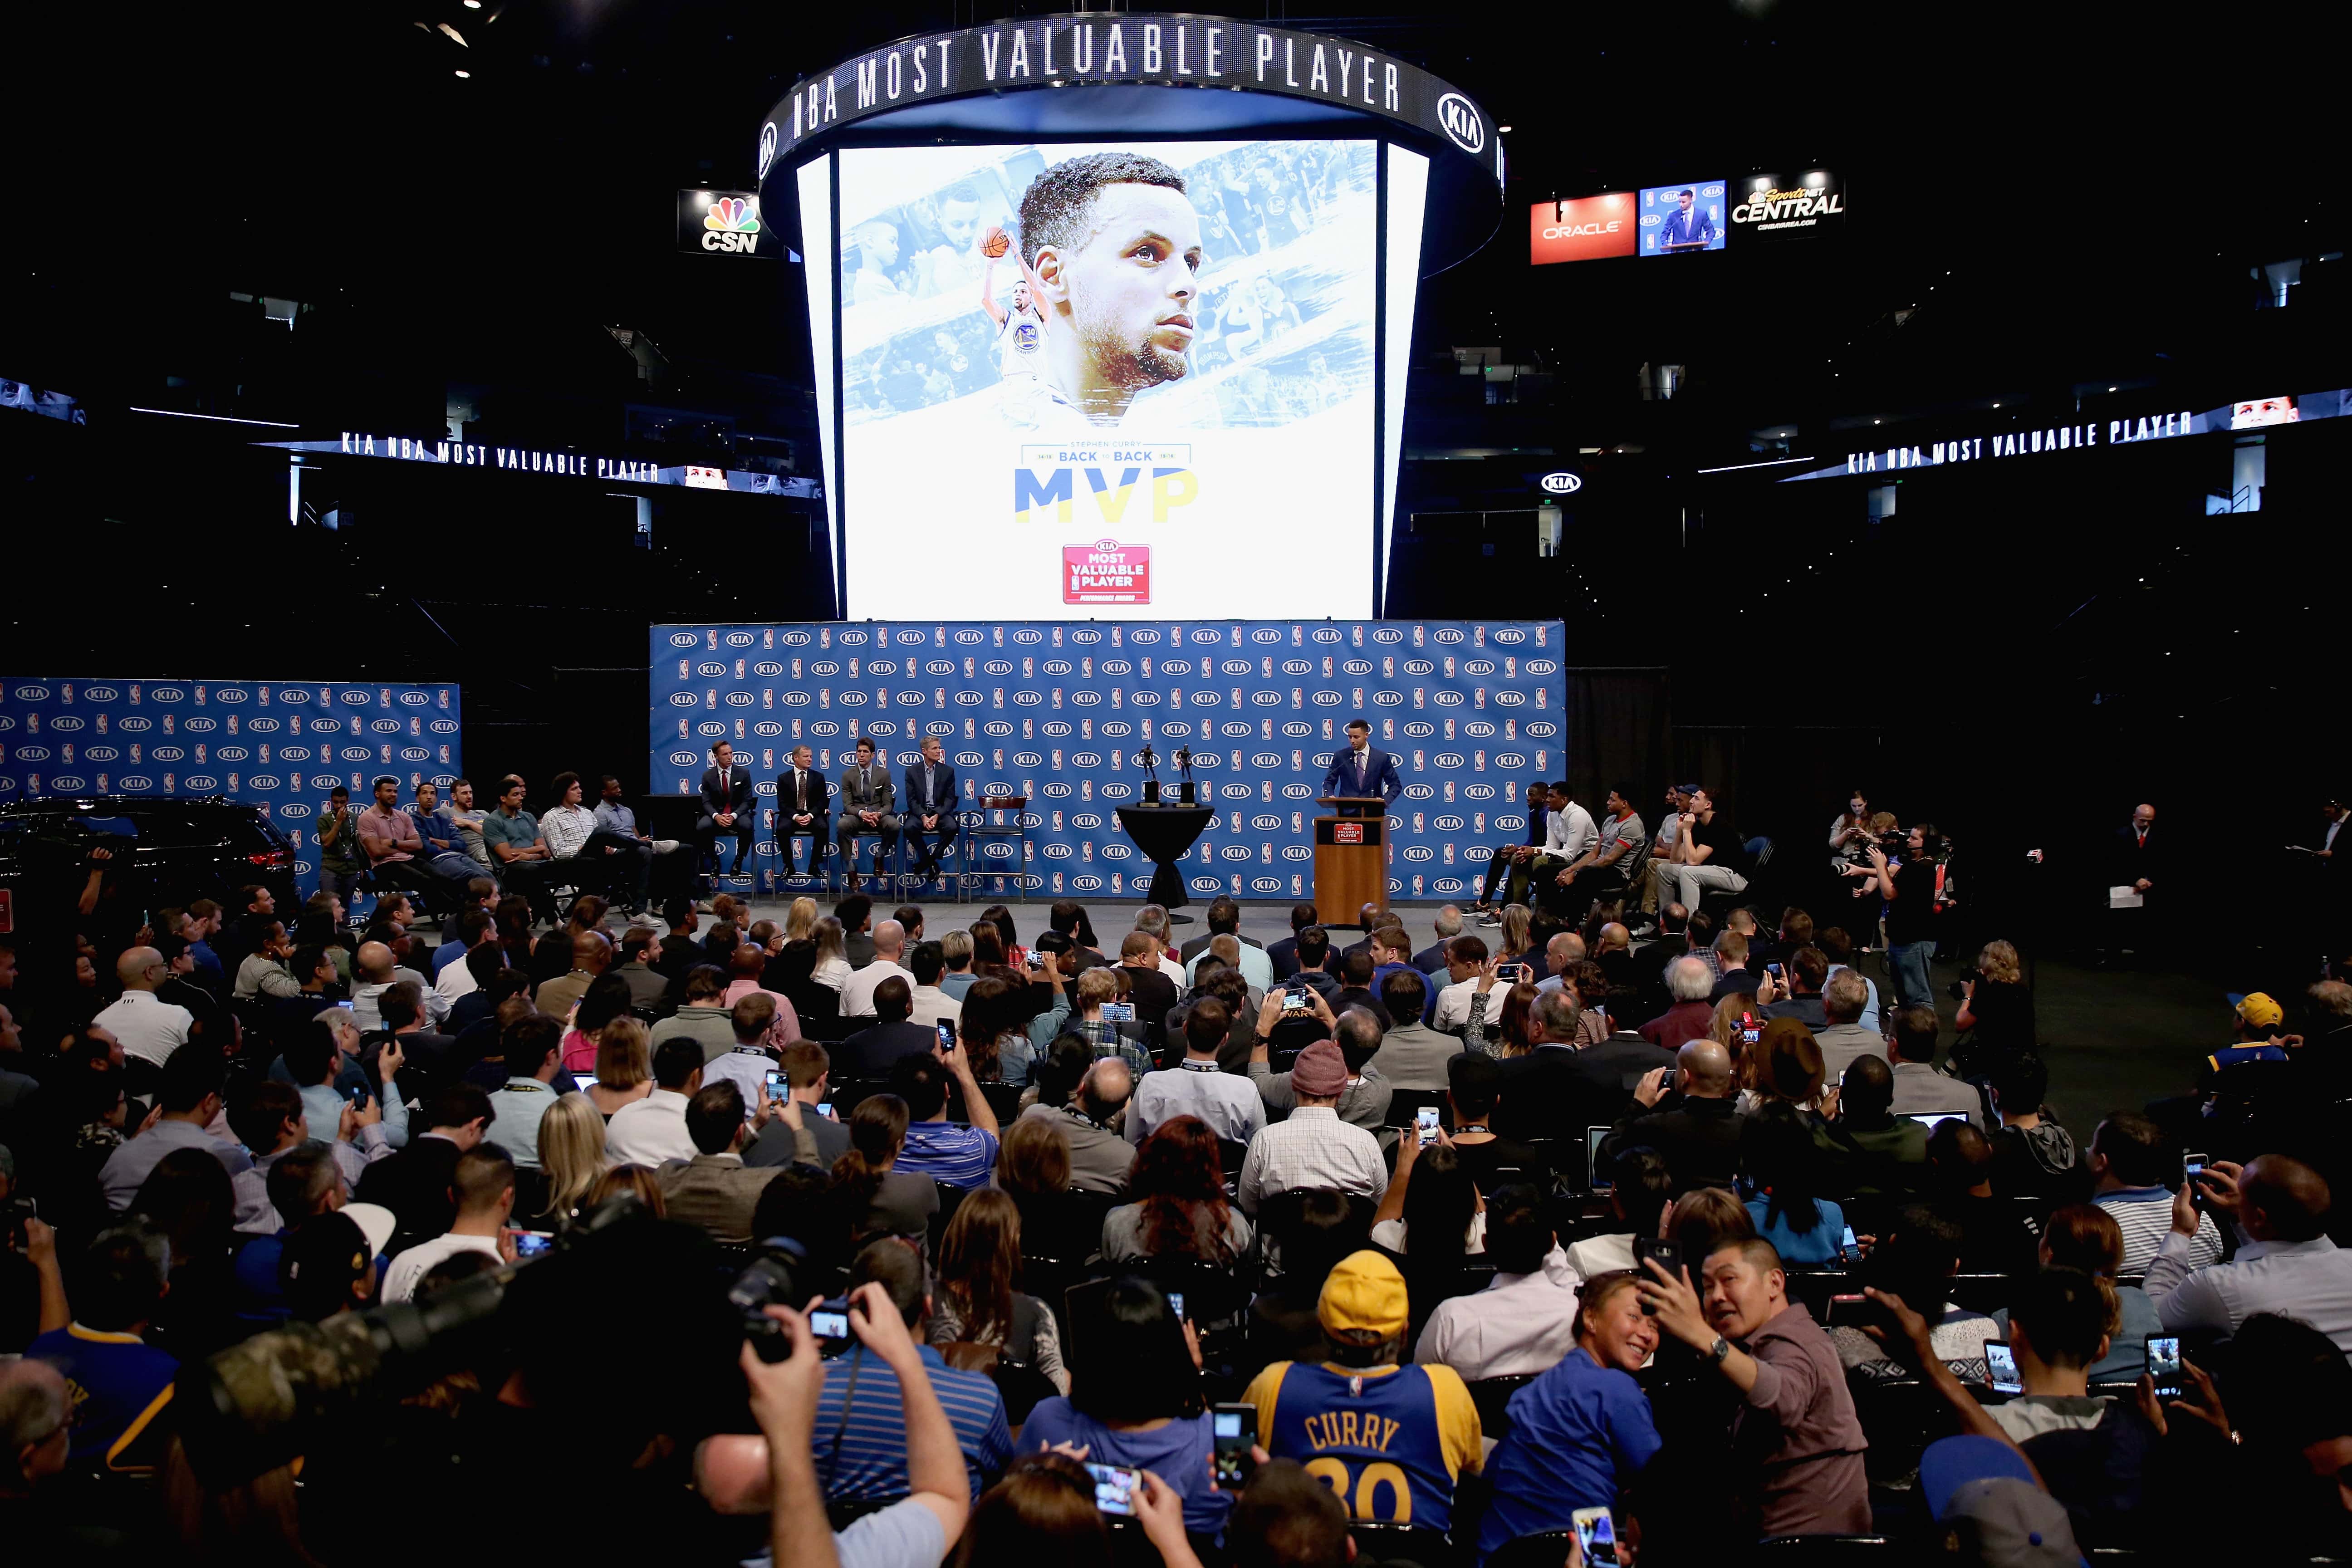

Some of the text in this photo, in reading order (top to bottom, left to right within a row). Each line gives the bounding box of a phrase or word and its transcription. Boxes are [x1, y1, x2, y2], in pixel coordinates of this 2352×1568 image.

[793, 24, 1399, 139] NBA MOST VALUABLE PLAYER
[1447, 100, 1479, 146] KIA
[1705, 187, 1721, 196] KIA
[1732, 194, 1843, 223] CENTRAL
[1543, 221, 1619, 240] ORACLE
[701, 230, 759, 254] CSN
[1198, 351, 1229, 366] THOMPSON
[1848, 412, 2191, 474] KIA NBA MOST VALUABLE PLAYER
[342, 432, 658, 482] KIA NBA MOST VALUABLE PLAYER
[1059, 452, 1098, 461] BACK
[1114, 451, 1153, 461] BACK
[1548, 477, 1574, 489] KIA
[1015, 468, 1199, 523] MVP
[1088, 553, 1126, 564] MOST
[1071, 565, 1144, 575] VALUABLE
[1081, 576, 1132, 587] PLAYER
[787, 635, 806, 643] KIA
[844, 634, 863, 642] KIA
[902, 633, 920, 642] KIA
[959, 633, 978, 641] KIA
[1018, 633, 1037, 641] KIA
[1077, 633, 1096, 641] KIA
[1137, 632, 1156, 641] KIA
[1196, 632, 1216, 641] KIA
[1257, 632, 1276, 641] KIA
[1317, 632, 1337, 640] KIA
[1378, 632, 1397, 641] KIA
[1439, 632, 1459, 641] KIA
[1500, 632, 1520, 641] KIA
[759, 665, 777, 673] KIA
[816, 664, 834, 672] KIA
[873, 664, 892, 672] KIA
[931, 663, 950, 672] KIA
[989, 663, 1008, 672] KIA
[1048, 663, 1067, 672] KIA
[1107, 663, 1126, 672] KIA
[1166, 663, 1186, 672] KIA
[1227, 663, 1246, 672] KIA
[1287, 663, 1307, 671] KIA
[1348, 663, 1367, 671] KIA
[1409, 663, 1428, 671] KIA
[1470, 663, 1490, 672] KIA
[1531, 663, 1551, 671] KIA
[21, 689, 44, 697] KIA
[222, 692, 242, 700] KIA
[346, 694, 365, 702] KIA
[844, 694, 862, 702] KIA
[902, 694, 920, 702] KIA
[959, 694, 978, 702] KIA
[1077, 694, 1096, 702] KIA
[1137, 694, 1156, 703] KIA
[1196, 694, 1215, 703] KIA
[1317, 694, 1337, 702] KIA
[1378, 694, 1398, 703] KIA
[1439, 694, 1459, 703] KIA
[1500, 694, 1520, 703] KIA
[56, 720, 78, 728] KIA
[125, 720, 146, 728] KIA
[191, 720, 211, 729] KIA
[255, 721, 274, 729] KIA
[316, 721, 335, 730] KIA
[376, 722, 395, 730] KIA
[759, 725, 778, 733] KIA
[816, 725, 834, 733] KIA
[931, 725, 949, 733] KIA
[989, 725, 1008, 733] KIA
[1048, 725, 1067, 733] KIA
[1166, 725, 1186, 734] KIA
[1227, 725, 1246, 734] KIA
[1287, 725, 1307, 734] KIA
[1409, 725, 1429, 734] KIA
[1470, 725, 1490, 734] KIA
[1531, 725, 1551, 734] KIA
[21, 750, 44, 758] KIA
[285, 750, 305, 758] KIA
[406, 750, 424, 758] KIA
[675, 755, 693, 763] KIA
[901, 755, 920, 763] KIA
[1018, 755, 1037, 764] KIA
[1196, 756, 1215, 764] KIA
[1257, 756, 1276, 764] KIA
[1439, 756, 1459, 765] KIA
[1500, 756, 1520, 765] KIA
[57, 779, 79, 788] KIA
[190, 779, 211, 787] KIA
[989, 785, 1008, 794] KIA
[1107, 786, 1126, 795] KIA
[1227, 787, 1246, 795] KIA
[1409, 787, 1429, 796] KIA
[1470, 787, 1490, 796] KIA
[286, 807, 305, 815] KIA
[1077, 817, 1096, 825] KIA
[1257, 818, 1276, 827] KIA
[1439, 818, 1459, 827] KIA
[1500, 818, 1519, 827] KIA
[989, 847, 1008, 855] KIA
[1107, 848, 1126, 856] KIA
[1287, 849, 1306, 858] KIA
[1470, 850, 1489, 858] KIA
[1078, 878, 1097, 887] KIA
[1196, 880, 1215, 888] KIA
[1257, 881, 1276, 889] KIA
[1438, 881, 1457, 889] KIA
[1304, 1411, 1400, 1452] CURRY
